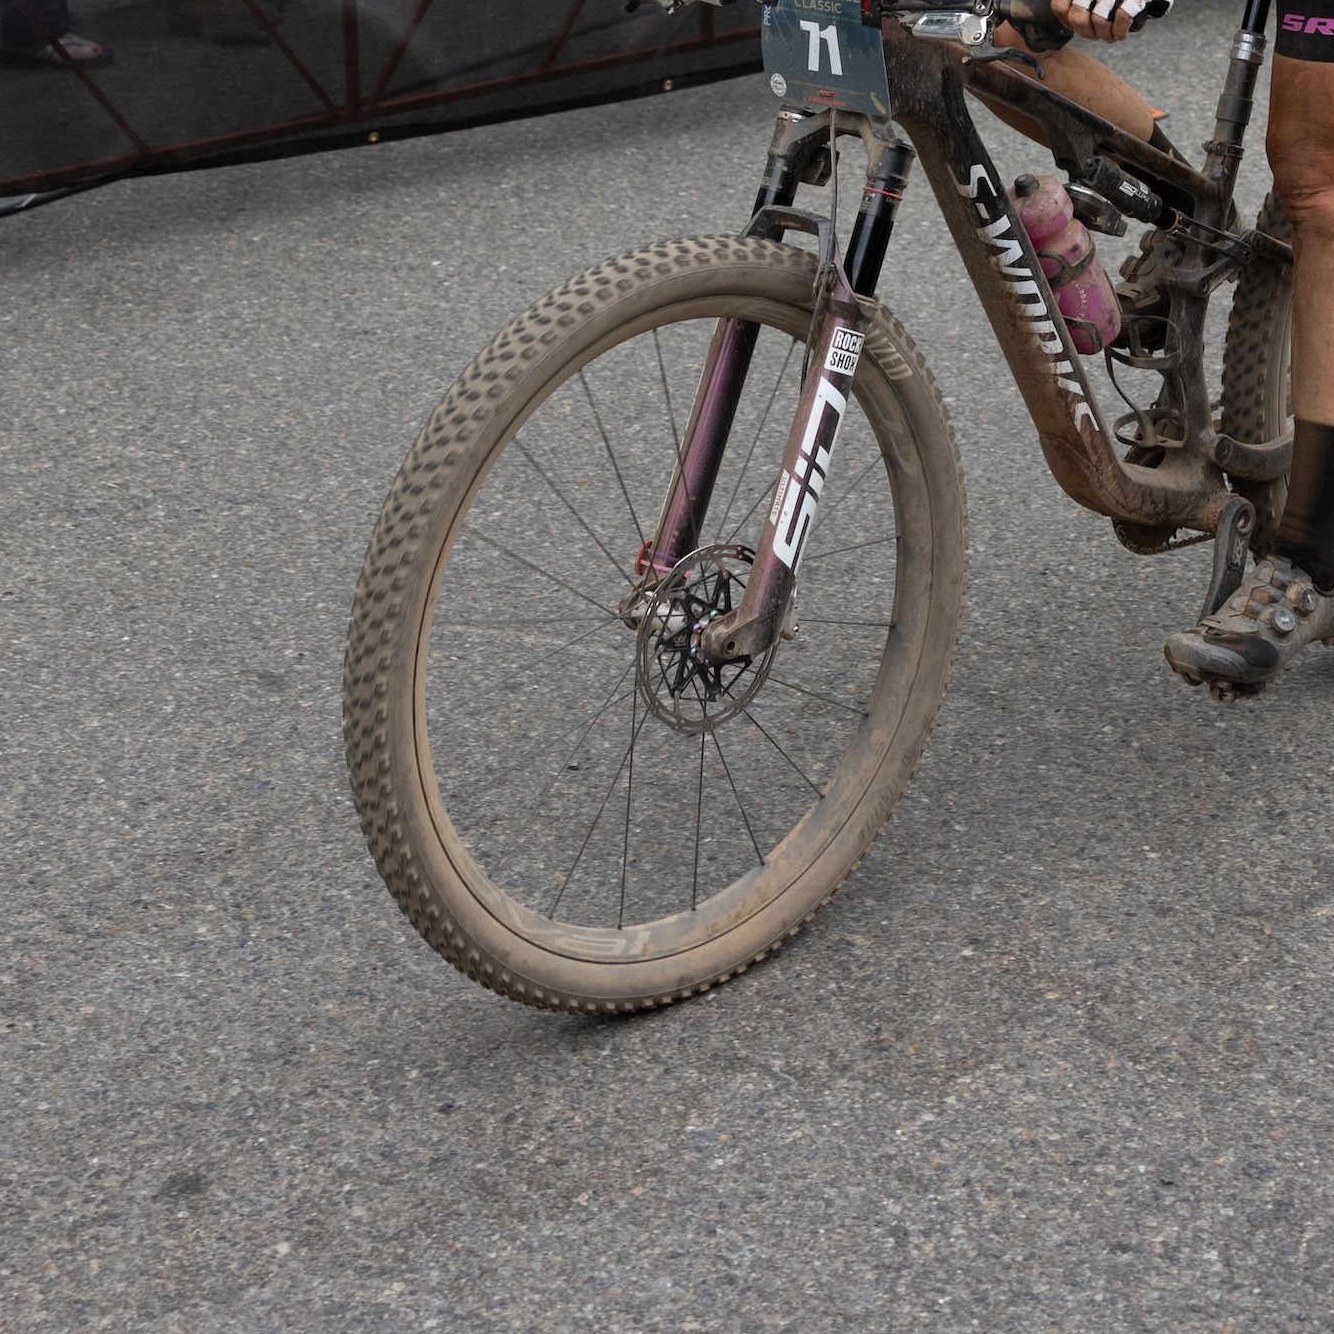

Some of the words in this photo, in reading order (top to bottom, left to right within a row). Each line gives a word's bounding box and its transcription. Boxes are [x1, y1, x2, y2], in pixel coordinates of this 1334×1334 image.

[799, 19, 843, 76] 71
[833, 330, 863, 354] ROCK
[829, 350, 858, 373] SHOX
